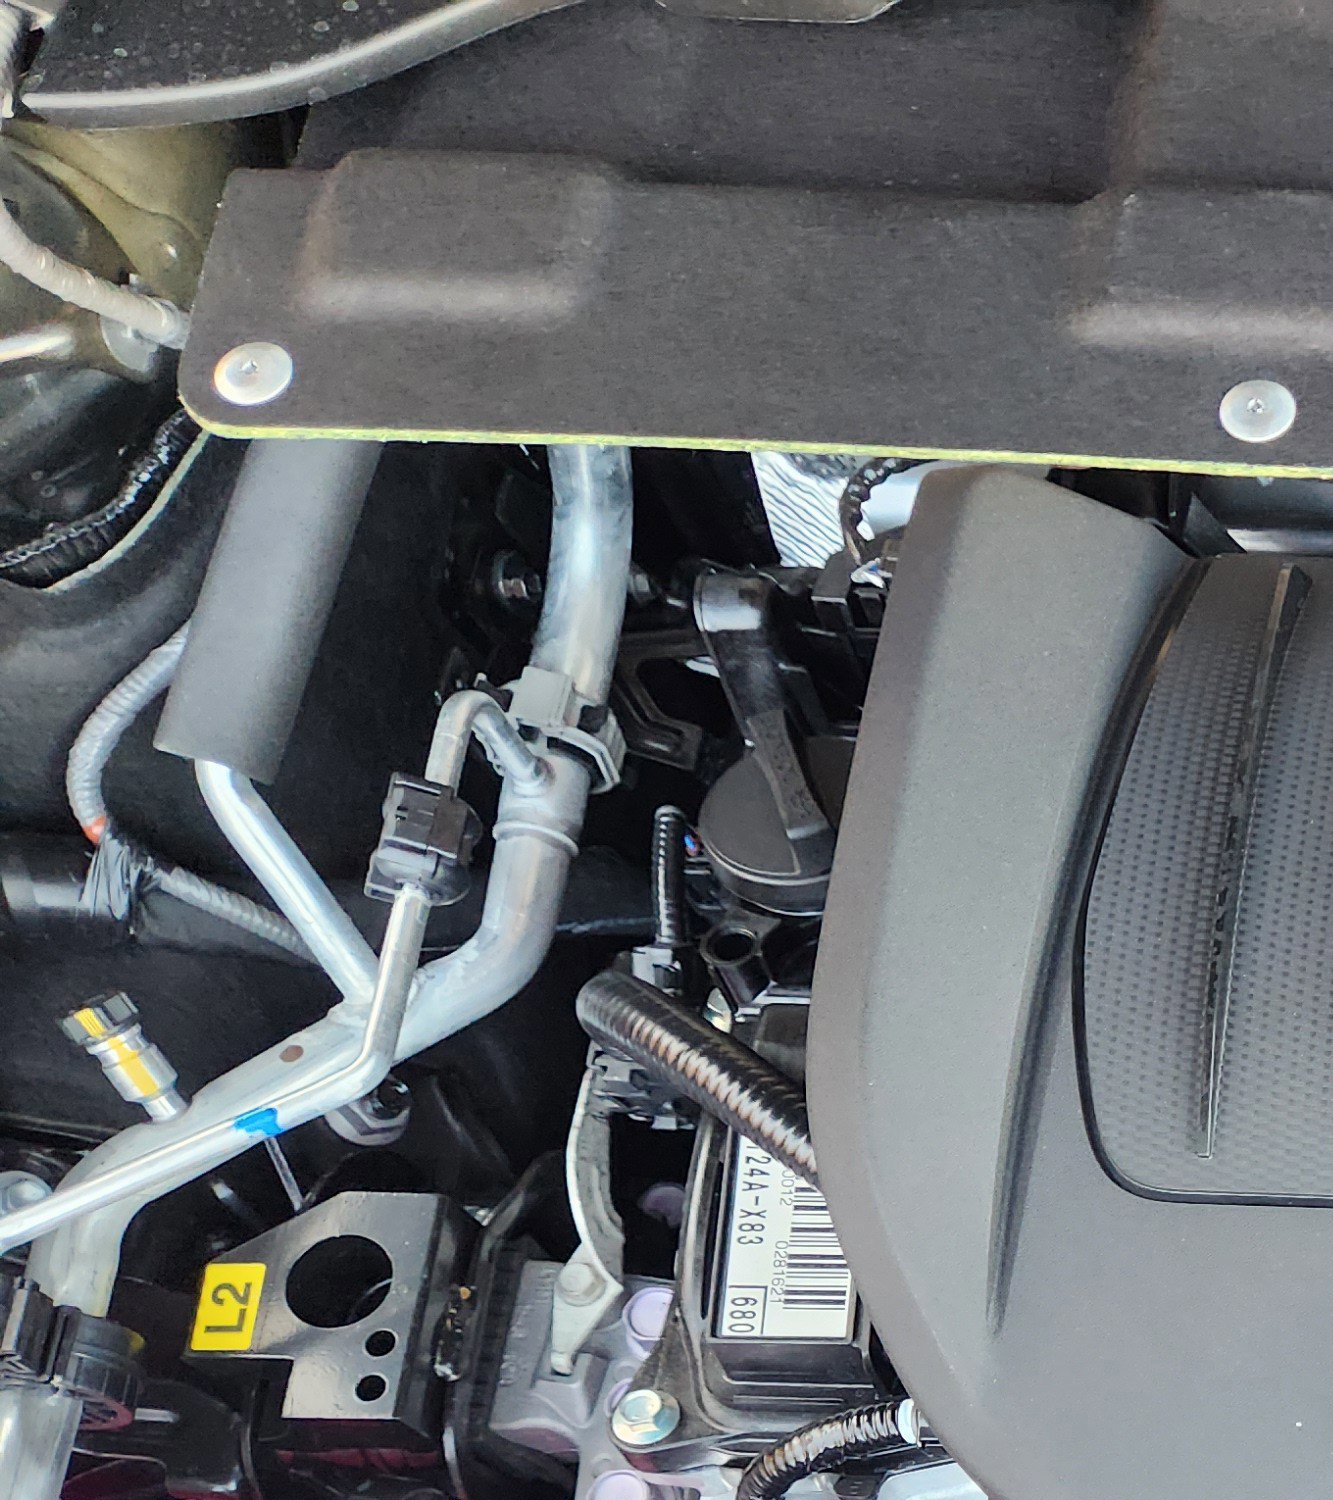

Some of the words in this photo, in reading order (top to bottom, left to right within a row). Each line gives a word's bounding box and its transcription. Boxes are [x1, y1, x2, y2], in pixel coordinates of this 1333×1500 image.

[770, 1241, 788, 1304] 0281621
[204, 1282, 252, 1333] L2
[728, 1296, 757, 1333] 680
